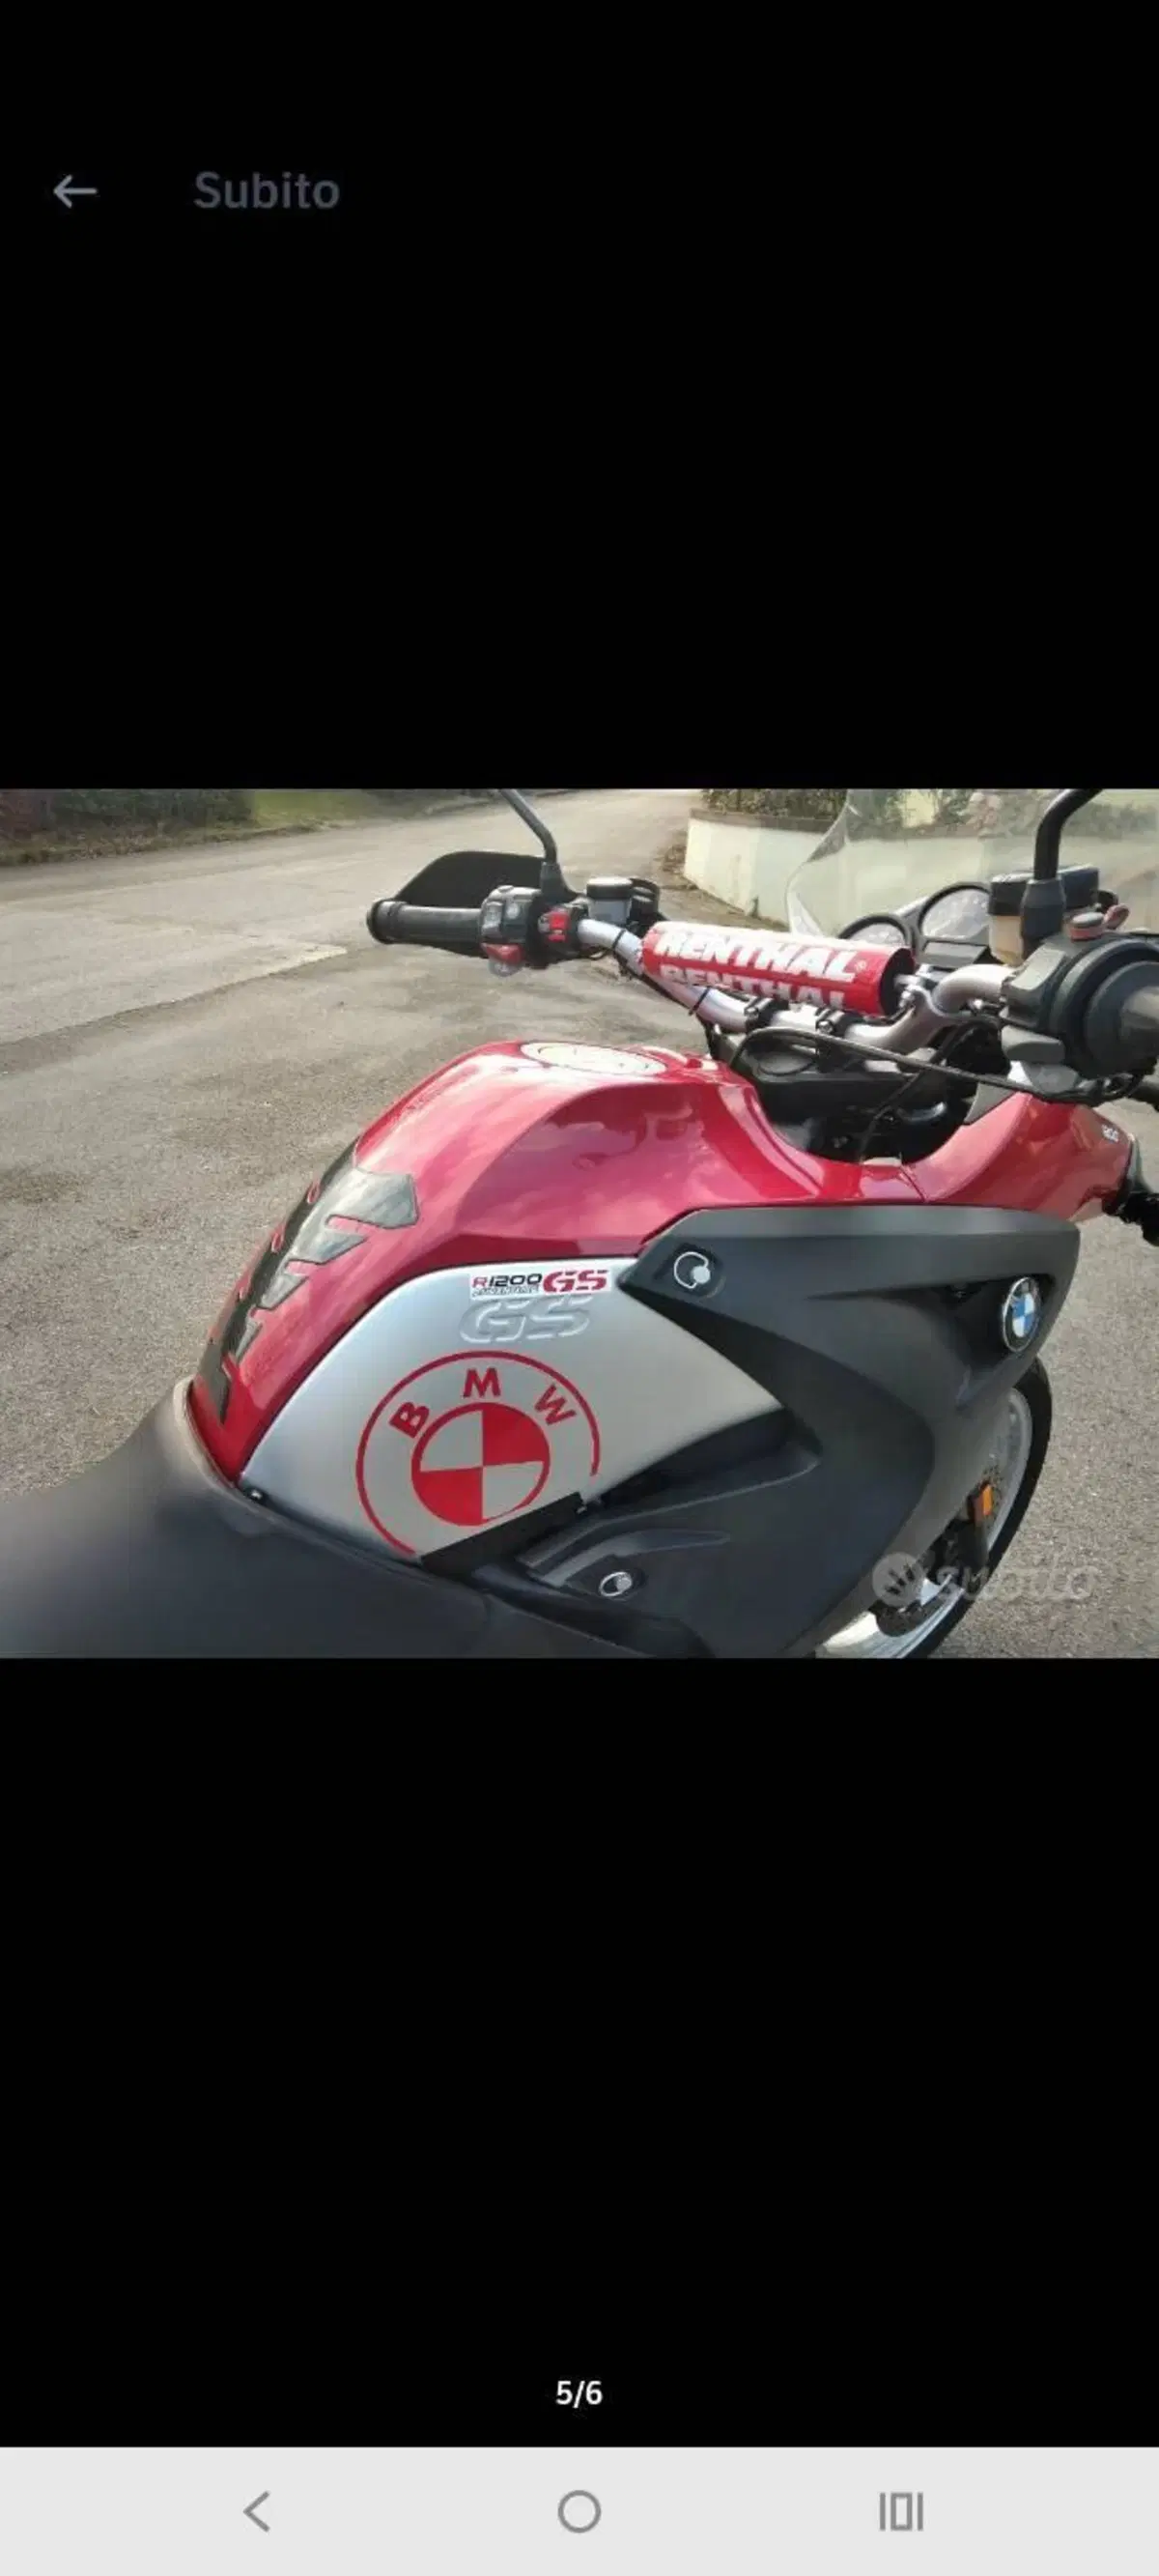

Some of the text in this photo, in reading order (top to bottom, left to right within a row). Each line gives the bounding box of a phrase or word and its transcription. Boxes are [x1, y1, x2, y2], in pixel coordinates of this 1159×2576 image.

[194, 172, 340, 210] Subito
[654, 925, 859, 984] RENTHAL
[471, 1273, 543, 1288] R1200
[543, 1270, 608, 1293] GS
[460, 1296, 593, 1343] GS
[555, 2380, 604, 2409] 5/6
